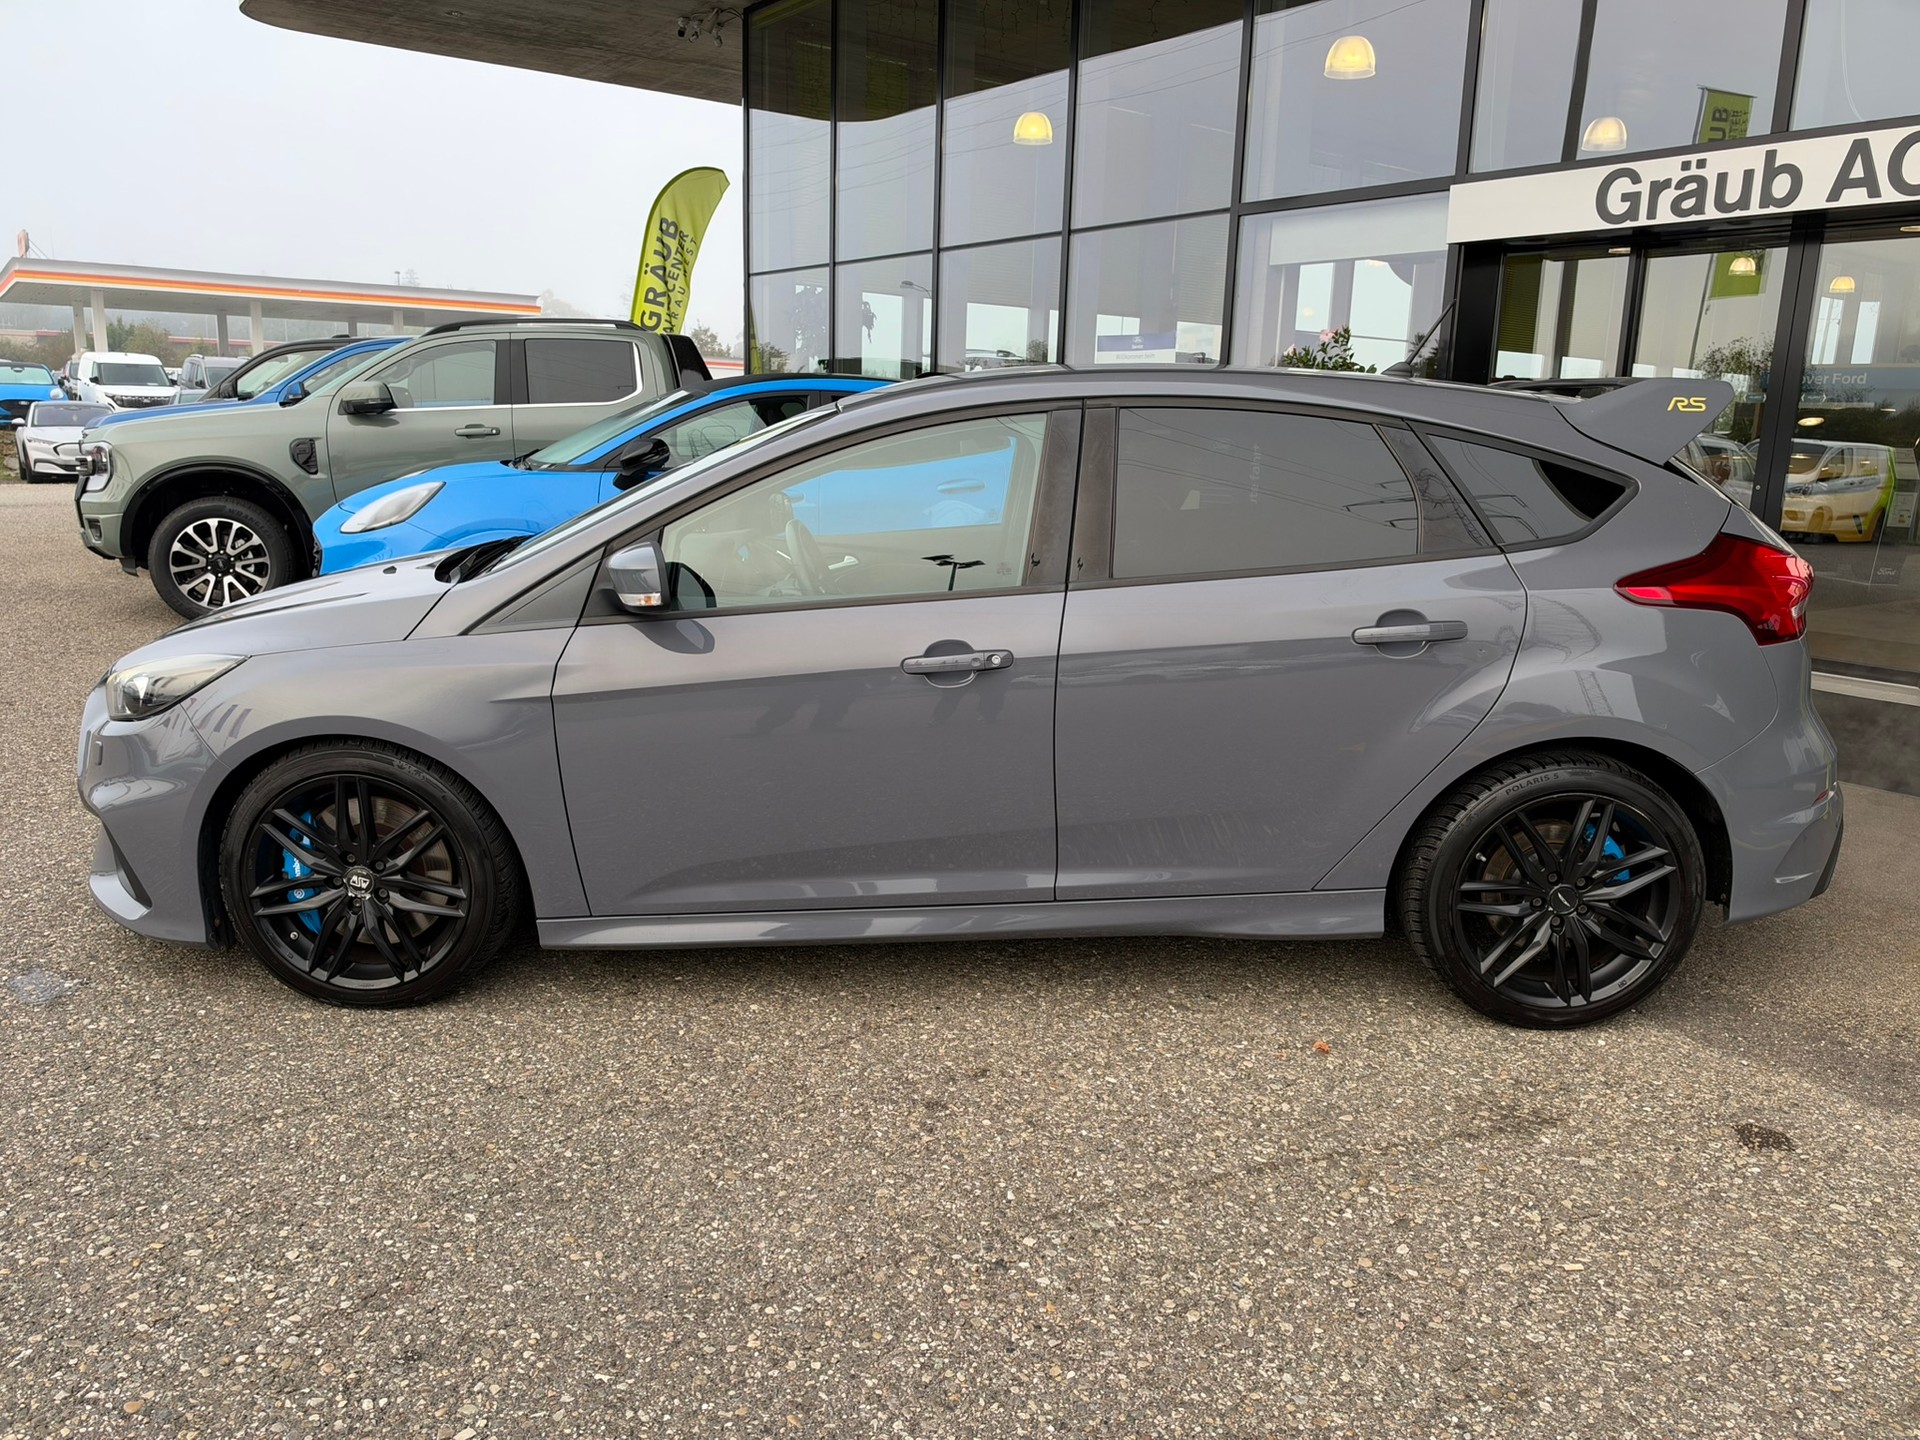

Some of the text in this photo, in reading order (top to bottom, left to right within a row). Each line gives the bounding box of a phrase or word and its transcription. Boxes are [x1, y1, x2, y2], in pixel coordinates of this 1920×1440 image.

[1595, 149, 1803, 225] Gräub
[640, 217, 680, 332] GRÄUB
[1832, 372, 1867, 385] Ford
[1667, 396, 1707, 412] RS
[1877, 567, 1897, 576] Ford
[1505, 773, 1560, 796] POLARIS 5
